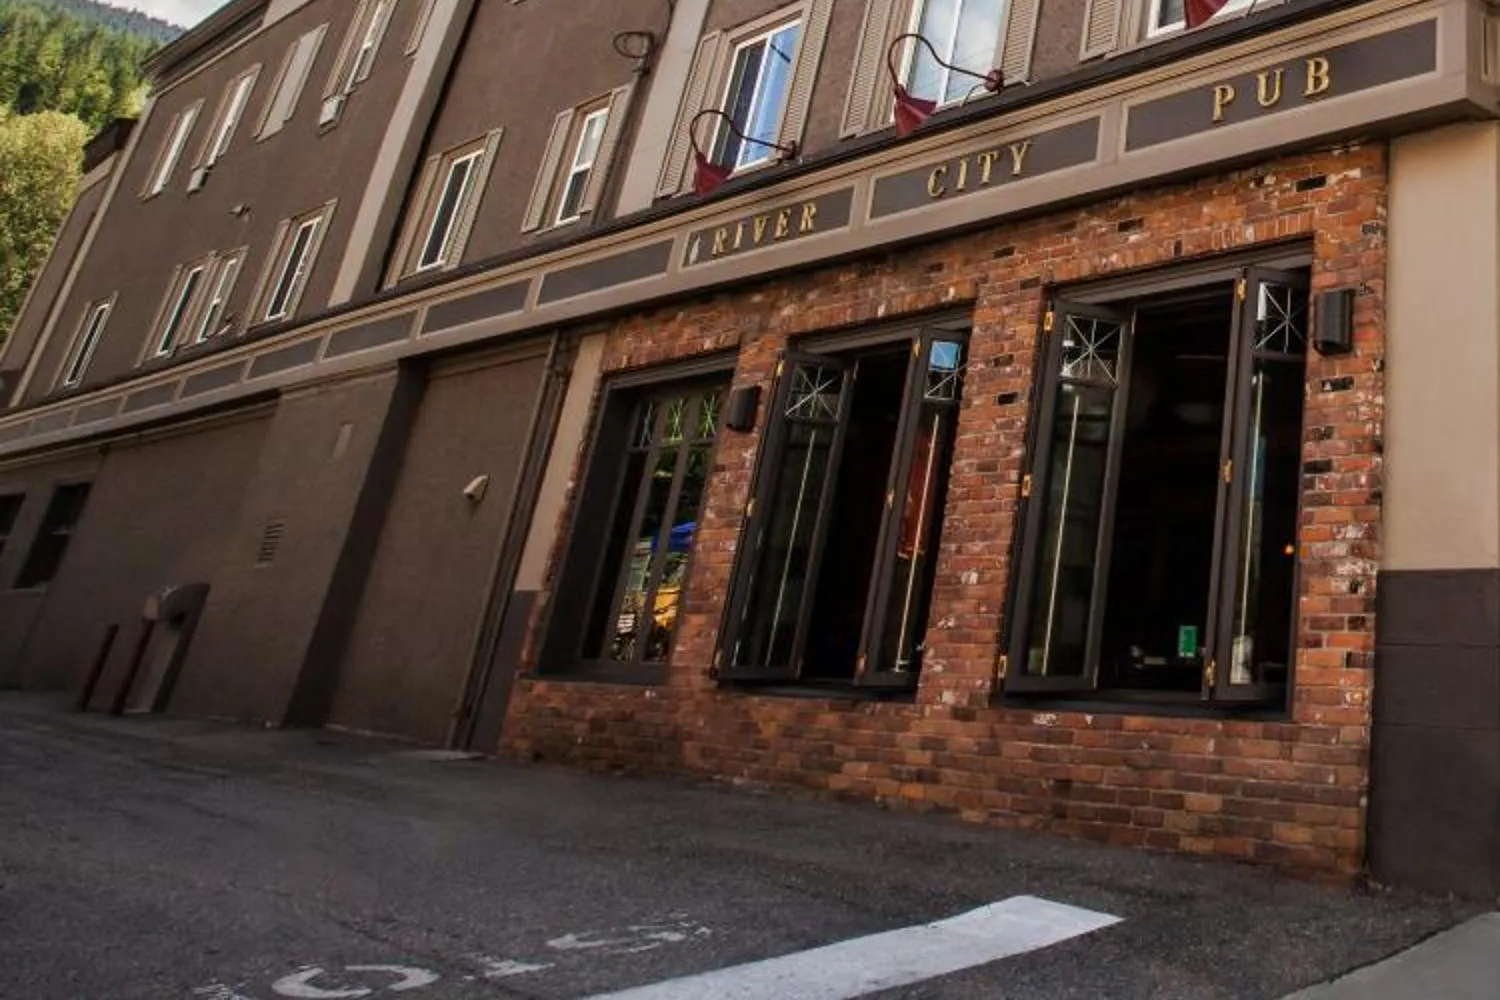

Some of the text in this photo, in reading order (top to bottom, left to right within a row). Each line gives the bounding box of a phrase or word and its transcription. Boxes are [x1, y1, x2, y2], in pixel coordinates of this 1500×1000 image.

[711, 56, 1331, 257] RIVER CITY PUB
